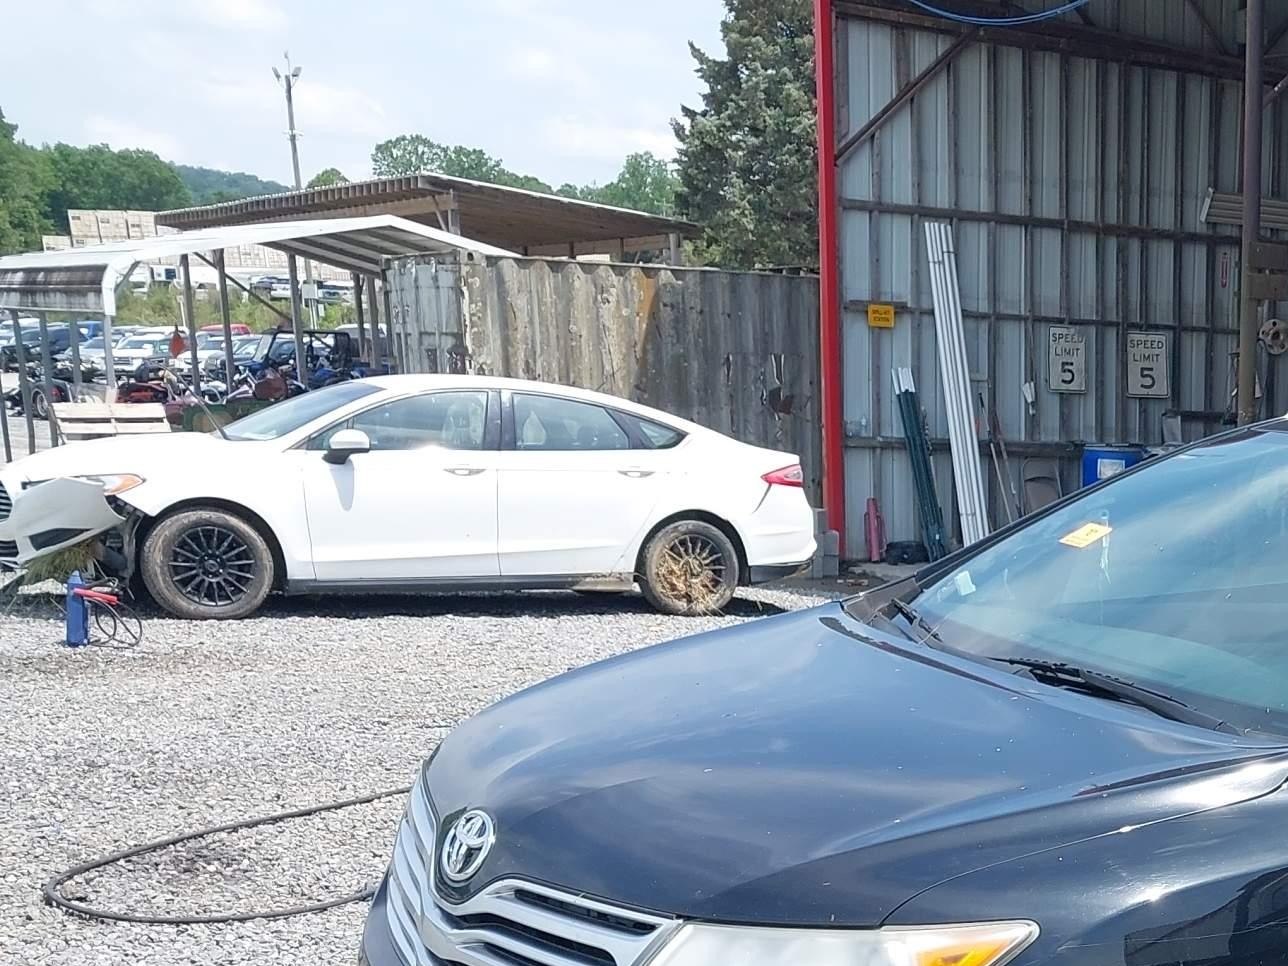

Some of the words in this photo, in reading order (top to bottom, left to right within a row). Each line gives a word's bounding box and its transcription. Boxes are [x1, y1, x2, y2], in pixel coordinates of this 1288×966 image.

[1051, 332, 1085, 344] SPEED
[1129, 339, 1165, 350] SPEED
[1054, 347, 1081, 358] LIMIT
[1132, 353, 1161, 363] LIMIT
[1061, 361, 1075, 385] 5
[1140, 367, 1156, 390] 5
